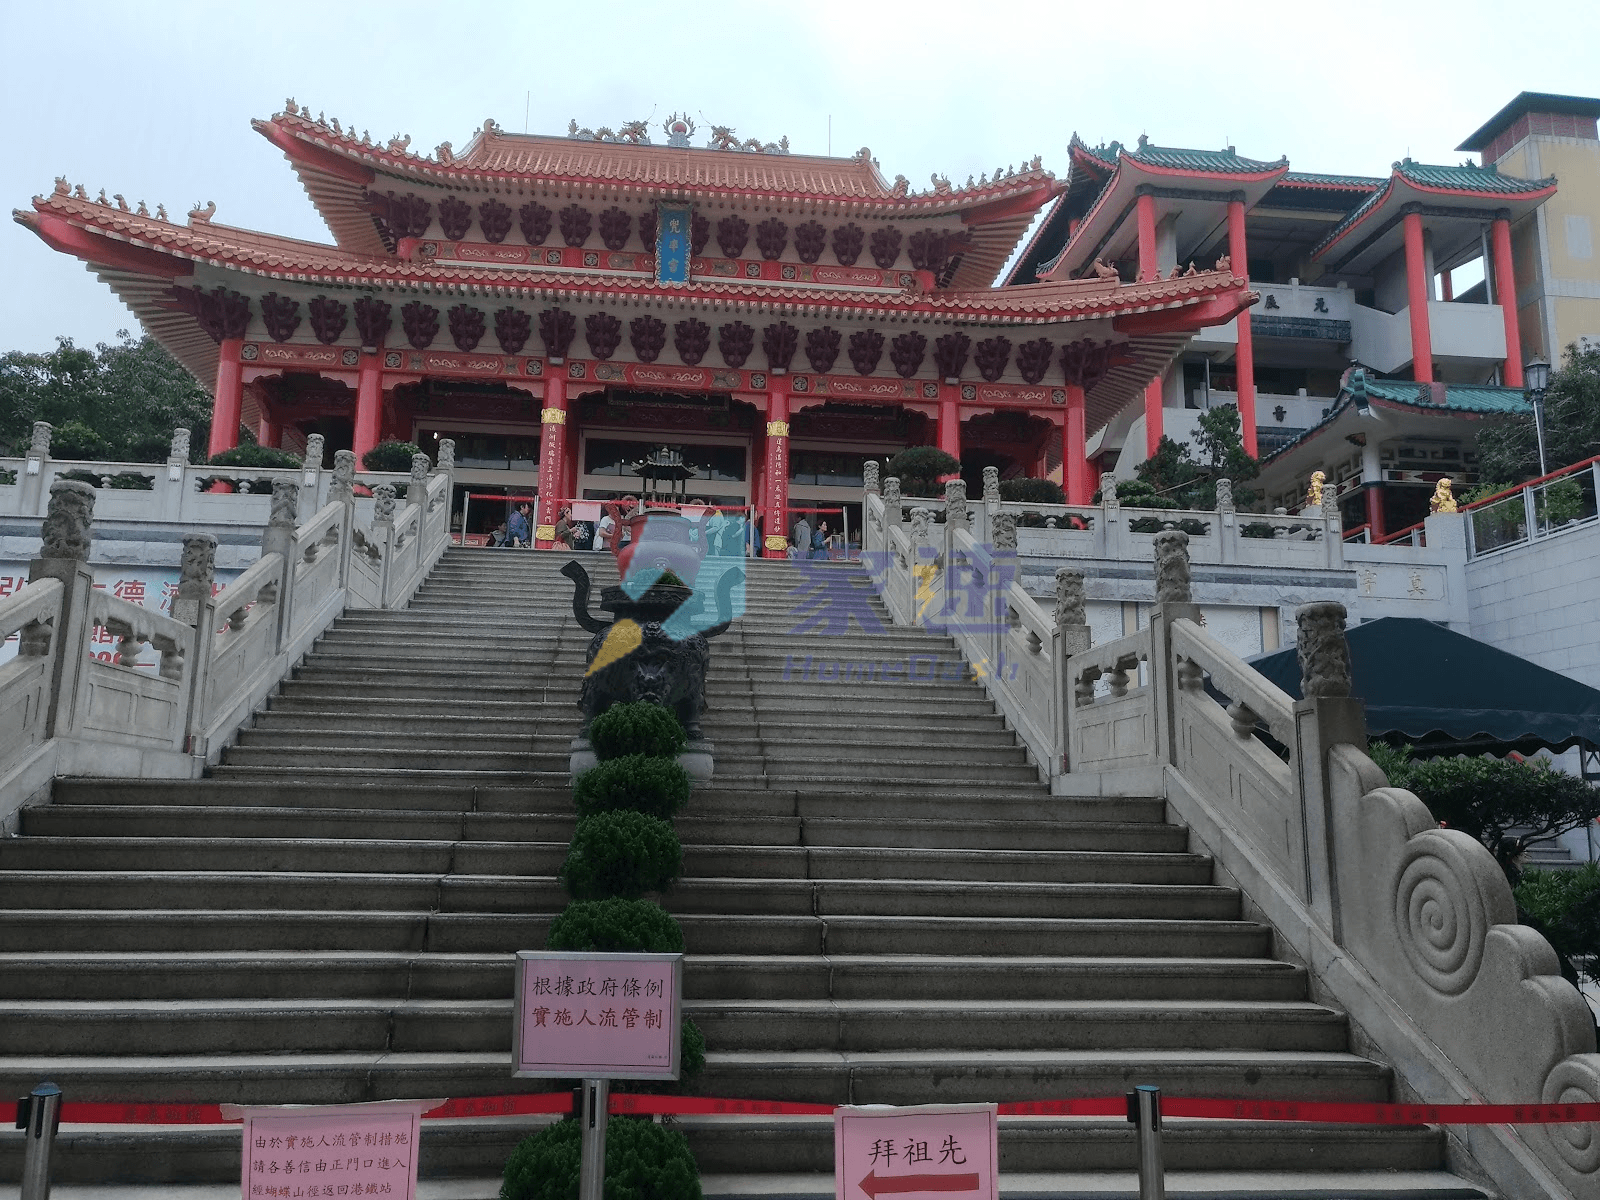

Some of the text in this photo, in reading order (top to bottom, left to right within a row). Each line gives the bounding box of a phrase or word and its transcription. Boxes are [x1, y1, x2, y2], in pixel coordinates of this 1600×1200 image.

[532, 976, 664, 999] 根據政府條例
[532, 1006, 663, 1030] 實施人流管制
[255, 1132, 409, 1150] 由於實施人流管制措施
[867, 1134, 967, 1168] 拜祖先
[252, 1157, 407, 1175] 請各善信由正門口進入
[251, 1182, 392, 1198] 經蝴蝶山徑返回港鐵站
